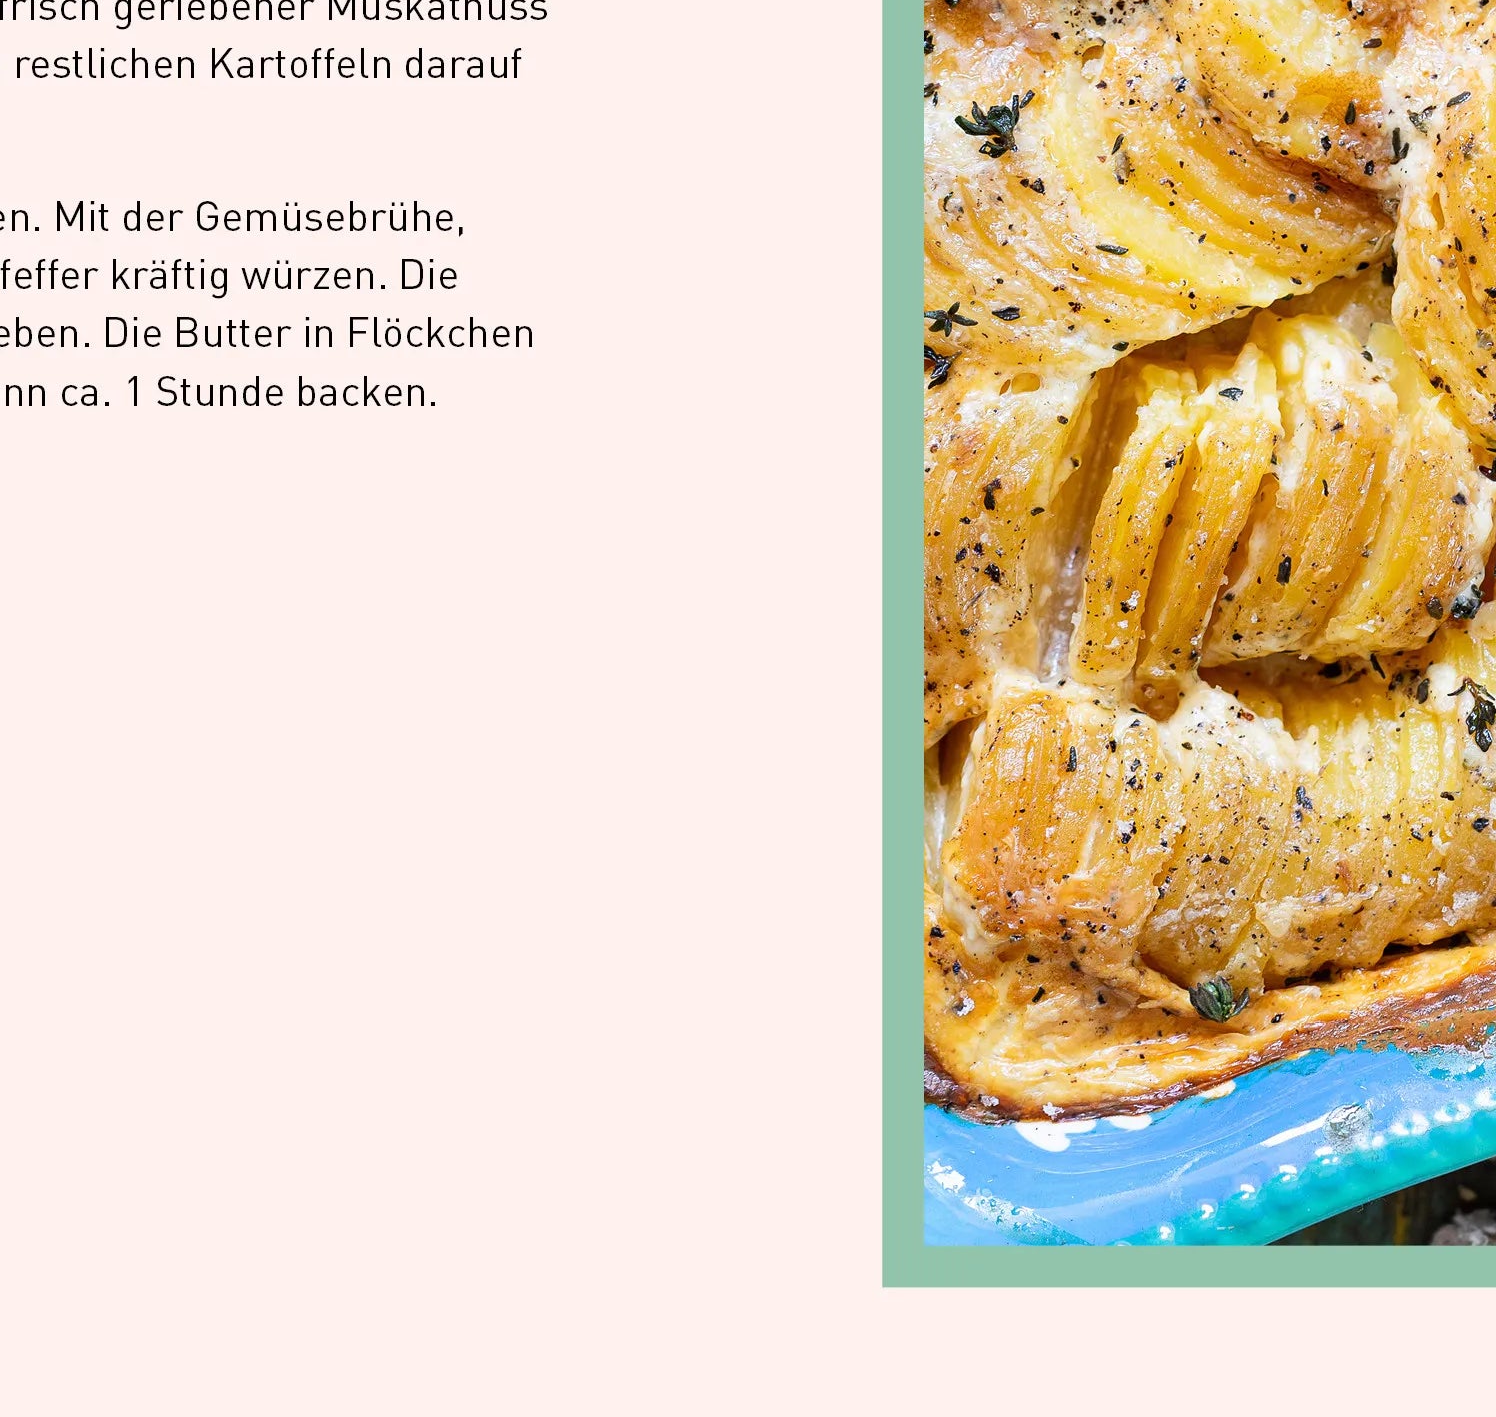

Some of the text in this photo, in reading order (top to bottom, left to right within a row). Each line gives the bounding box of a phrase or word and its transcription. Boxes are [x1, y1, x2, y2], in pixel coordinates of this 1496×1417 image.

[16, 47, 195, 79] restlichen
[211, 47, 391, 79] Kartoffeln
[405, 47, 523, 79] darauf
[56, 200, 110, 232] Mit
[123, 200, 185, 232] der
[196, 200, 464, 238] Gemüsebrühe,
[112, 258, 228, 300] kräftig
[240, 259, 386, 290] würzen.
[401, 258, 458, 290] Die
[105, 316, 162, 348] Die
[176, 315, 293, 348] Butter
[304, 316, 333, 348] in
[349, 316, 533, 348] Flöckchen
[61, 384, 110, 407] ca.
[127, 375, 138, 407] 1
[156, 375, 284, 407] Stunde
[298, 375, 436, 407] backen.
